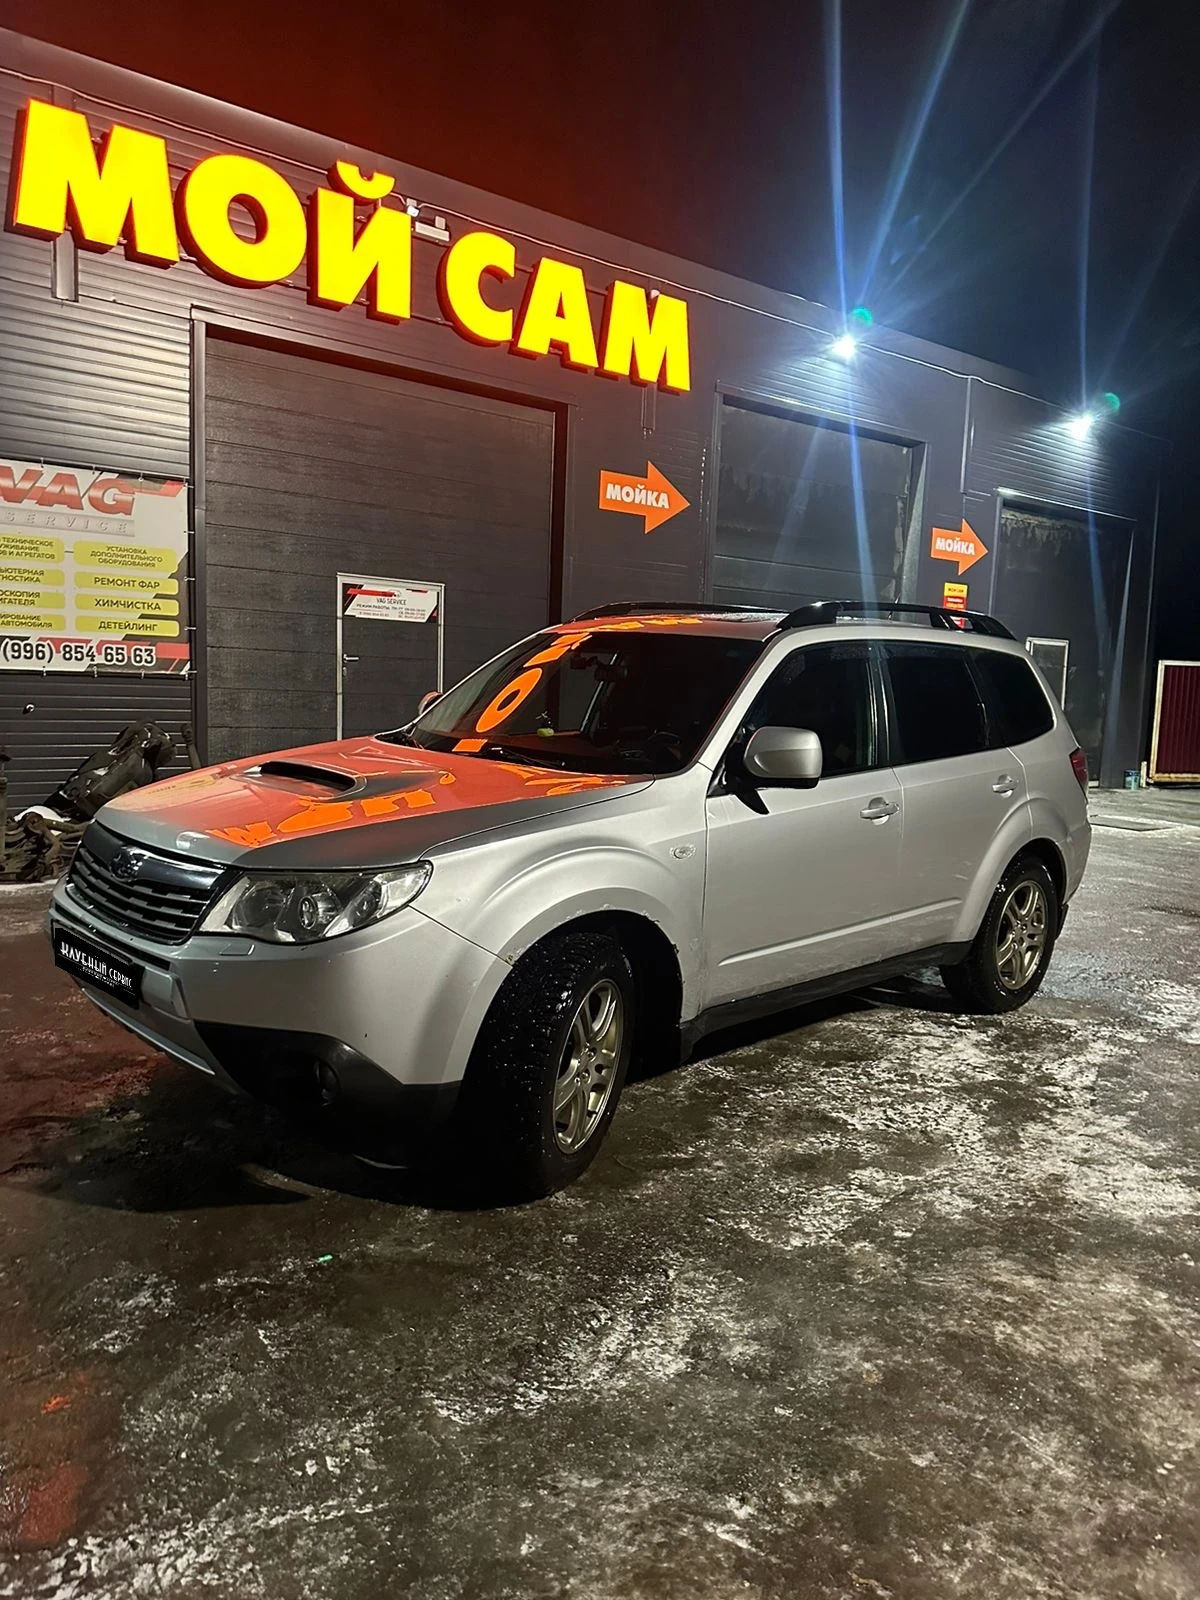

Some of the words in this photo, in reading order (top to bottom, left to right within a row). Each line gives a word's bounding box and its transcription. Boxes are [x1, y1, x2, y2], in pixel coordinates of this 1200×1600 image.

[9, 98, 413, 322] МОЙ
[440, 231, 691, 392] САМ
[0, 465, 134, 516] VAG
[606, 483, 670, 509] МОЙКА
[7, 510, 128, 534] SERVICE
[2, 536, 54, 547] ТЕХНИЧЕСКОЕ
[935, 537, 975, 556] МОЙКА
[15, 551, 56, 560] АГРЕГАТОВ
[90, 550, 163, 562] ДОПОЛНИТЕЛЬНОГО
[106, 545, 148, 555] УСТАНОВКА
[98, 557, 156, 568] ОБОРУДОВАНИЯ
[94, 577, 136, 588] РЕМОНТ
[138, 580, 160, 589] ФАР
[94, 598, 162, 610] ХИМЧИСТКА
[1, 619, 53, 629] АВТОМОБИЛЯ
[98, 620, 159, 632] ДЕТЕЙЛИНГ
[3, 641, 54, 664] (996)
[62, 644, 96, 662] 854
[104, 646, 126, 663] 65
[133, 647, 155, 664] 63
